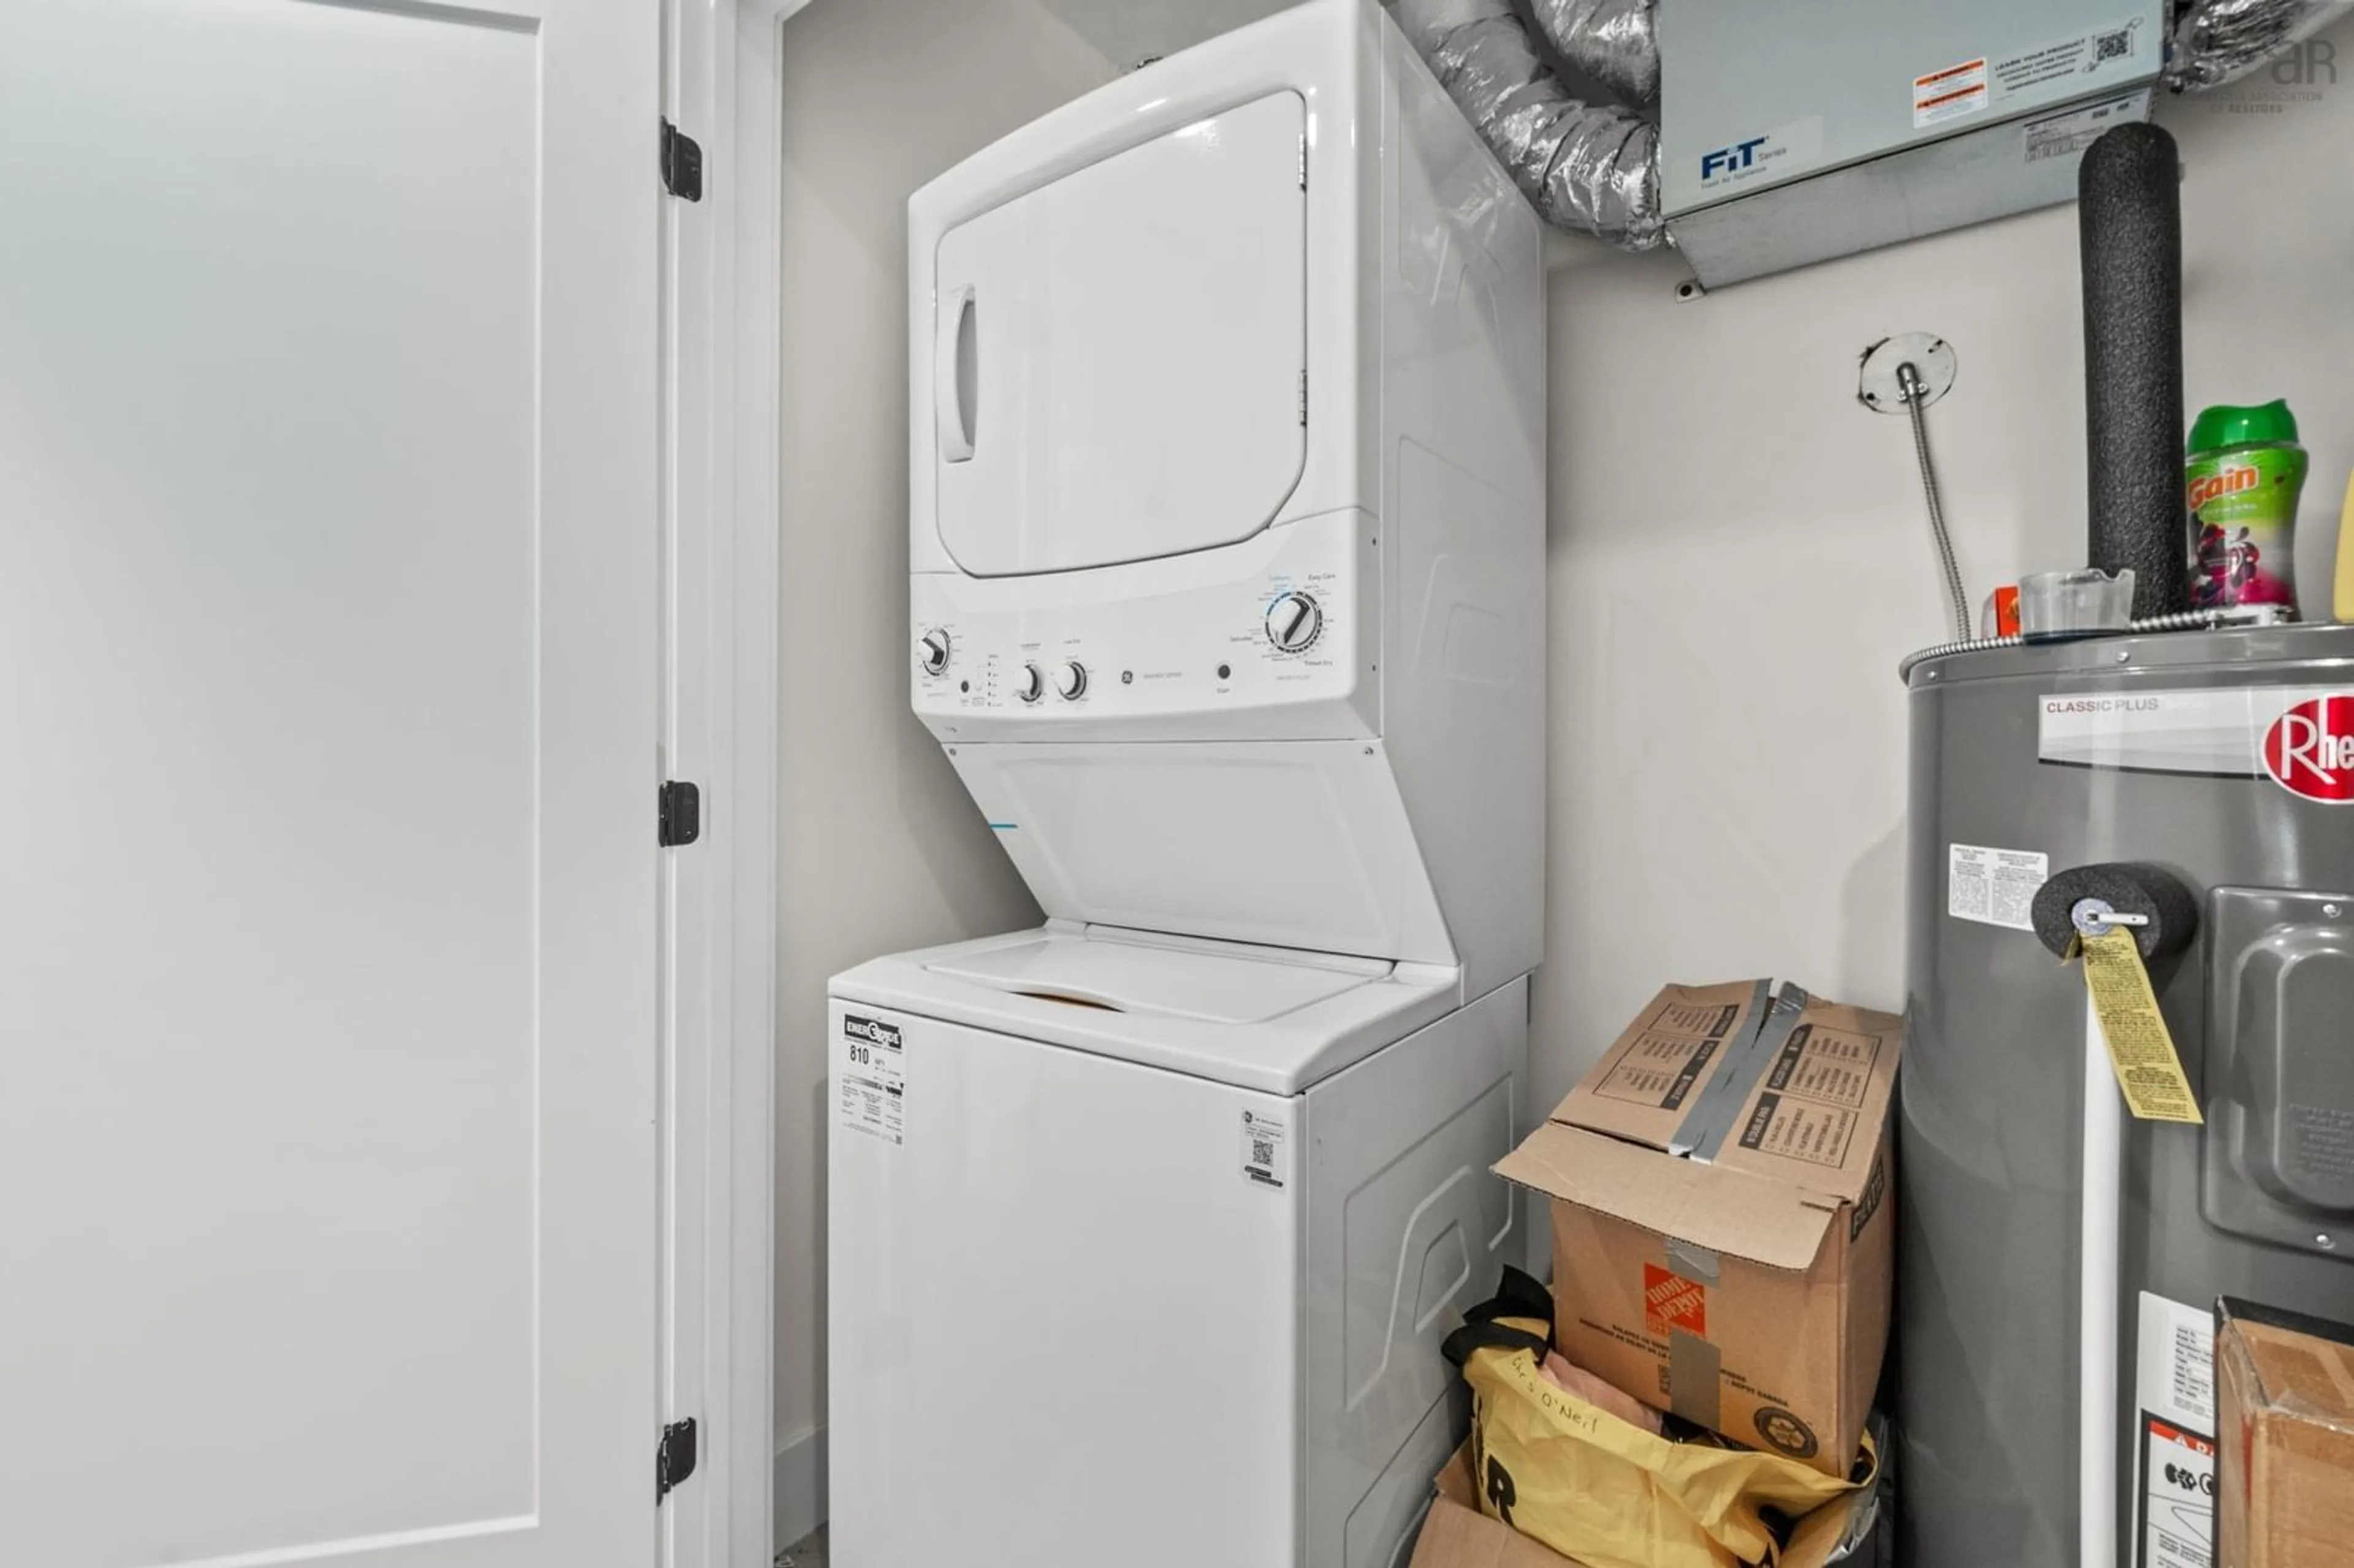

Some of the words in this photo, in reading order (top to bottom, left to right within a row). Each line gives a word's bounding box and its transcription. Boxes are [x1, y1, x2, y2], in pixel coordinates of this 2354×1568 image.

[2187, 467, 2260, 511] Gain
[2046, 700, 2112, 714] CLASSIC
[2116, 697, 2160, 711] PLUS
[850, 1044, 869, 1065] 810
[1647, 1276, 1691, 1306] HOME
